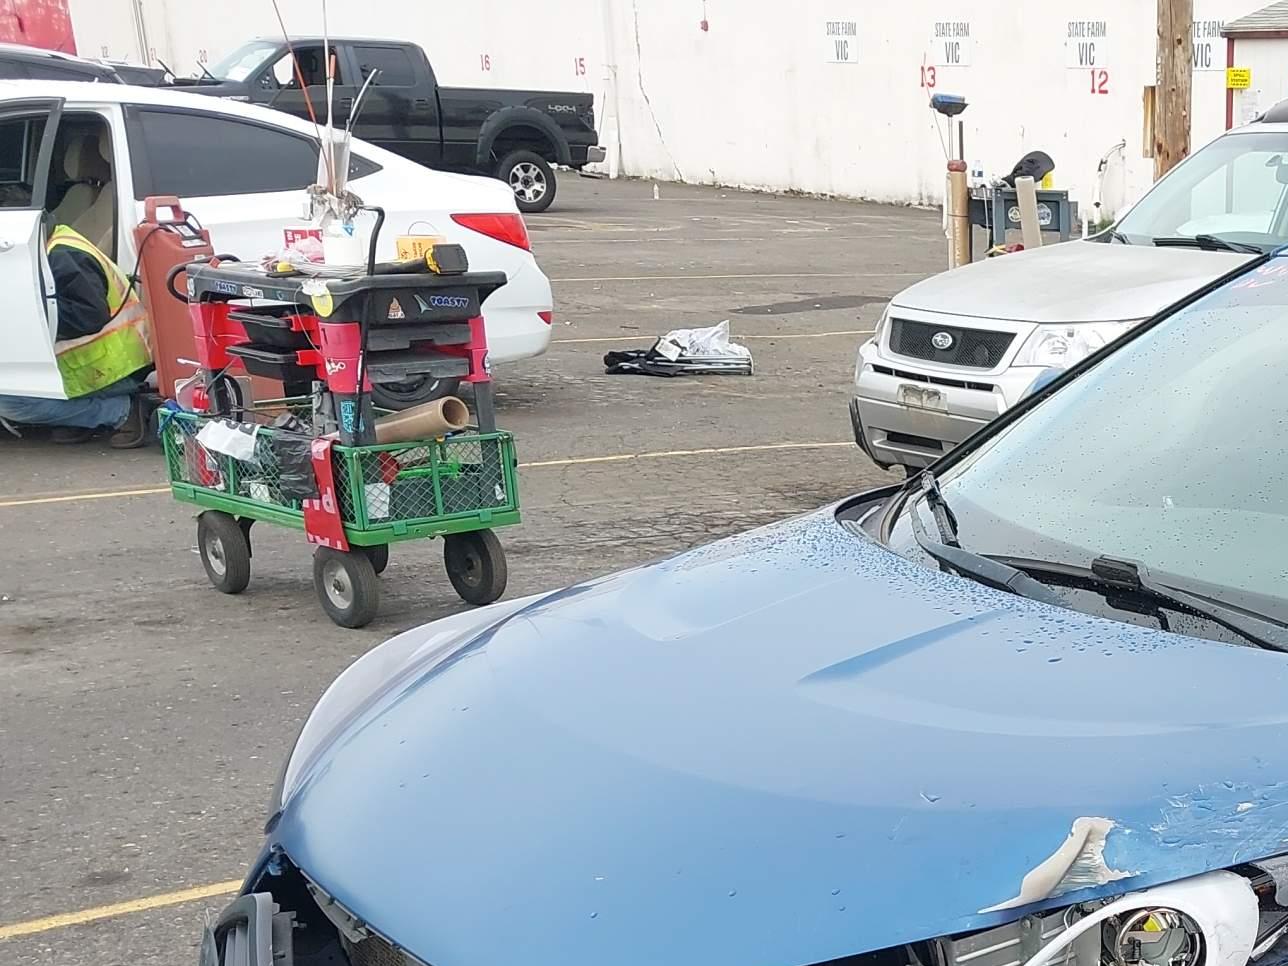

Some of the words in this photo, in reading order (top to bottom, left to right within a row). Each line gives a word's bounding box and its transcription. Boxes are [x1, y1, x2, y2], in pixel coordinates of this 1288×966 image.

[826, 21, 841, 36] STATE
[842, 22, 857, 36] FARM
[935, 22, 951, 37] STATE
[952, 22, 970, 37] FARM
[1067, 21, 1086, 38] STATE
[1087, 22, 1107, 38] FARM
[835, 40, 849, 61] VIC
[945, 42, 960, 64] VIC
[1078, 42, 1095, 66] VIC
[1192, 43, 1212, 68] VIC
[574, 57, 586, 76] 15
[920, 66, 936, 88] 13
[1090, 70, 1109, 94] 12
